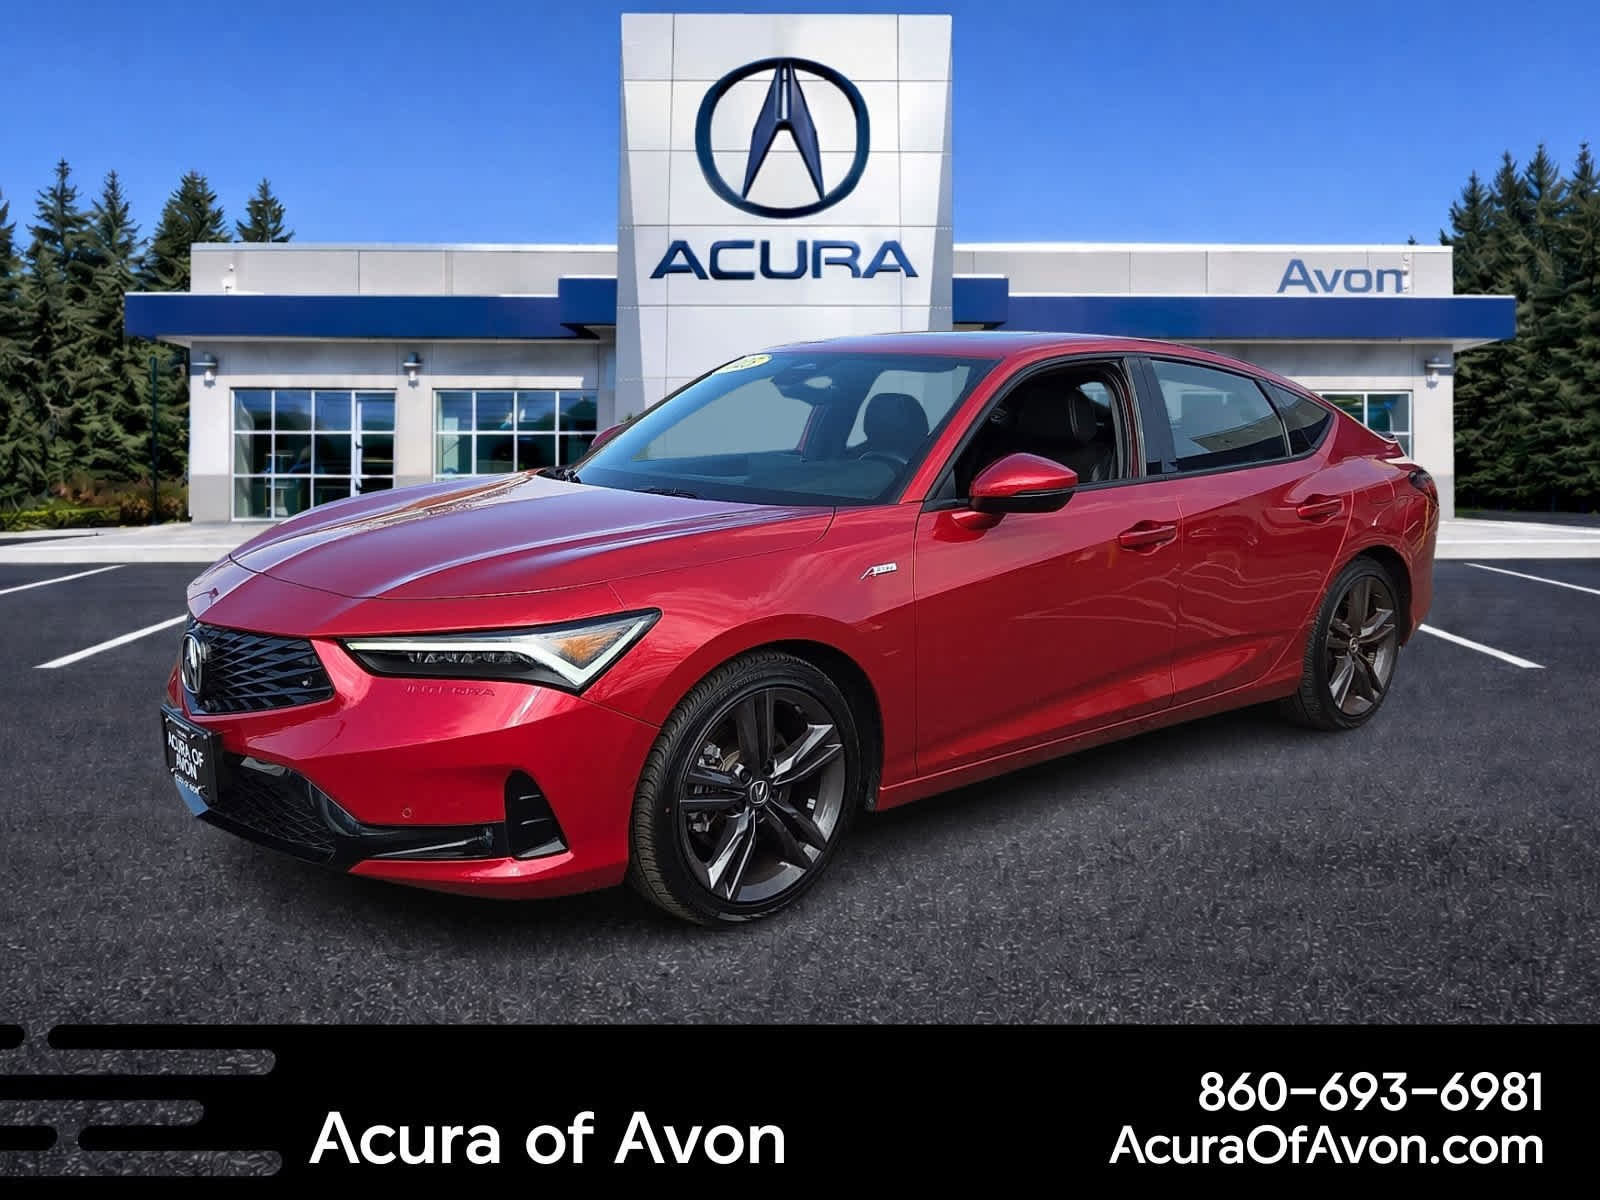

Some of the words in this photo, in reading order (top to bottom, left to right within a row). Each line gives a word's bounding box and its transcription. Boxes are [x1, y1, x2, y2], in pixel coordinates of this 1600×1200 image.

[650, 240, 919, 280] ACURA
[1277, 258, 1404, 294] Avon
[168, 731, 191, 761] ACURA
[191, 748, 204, 767] OF
[176, 753, 198, 780] AVON
